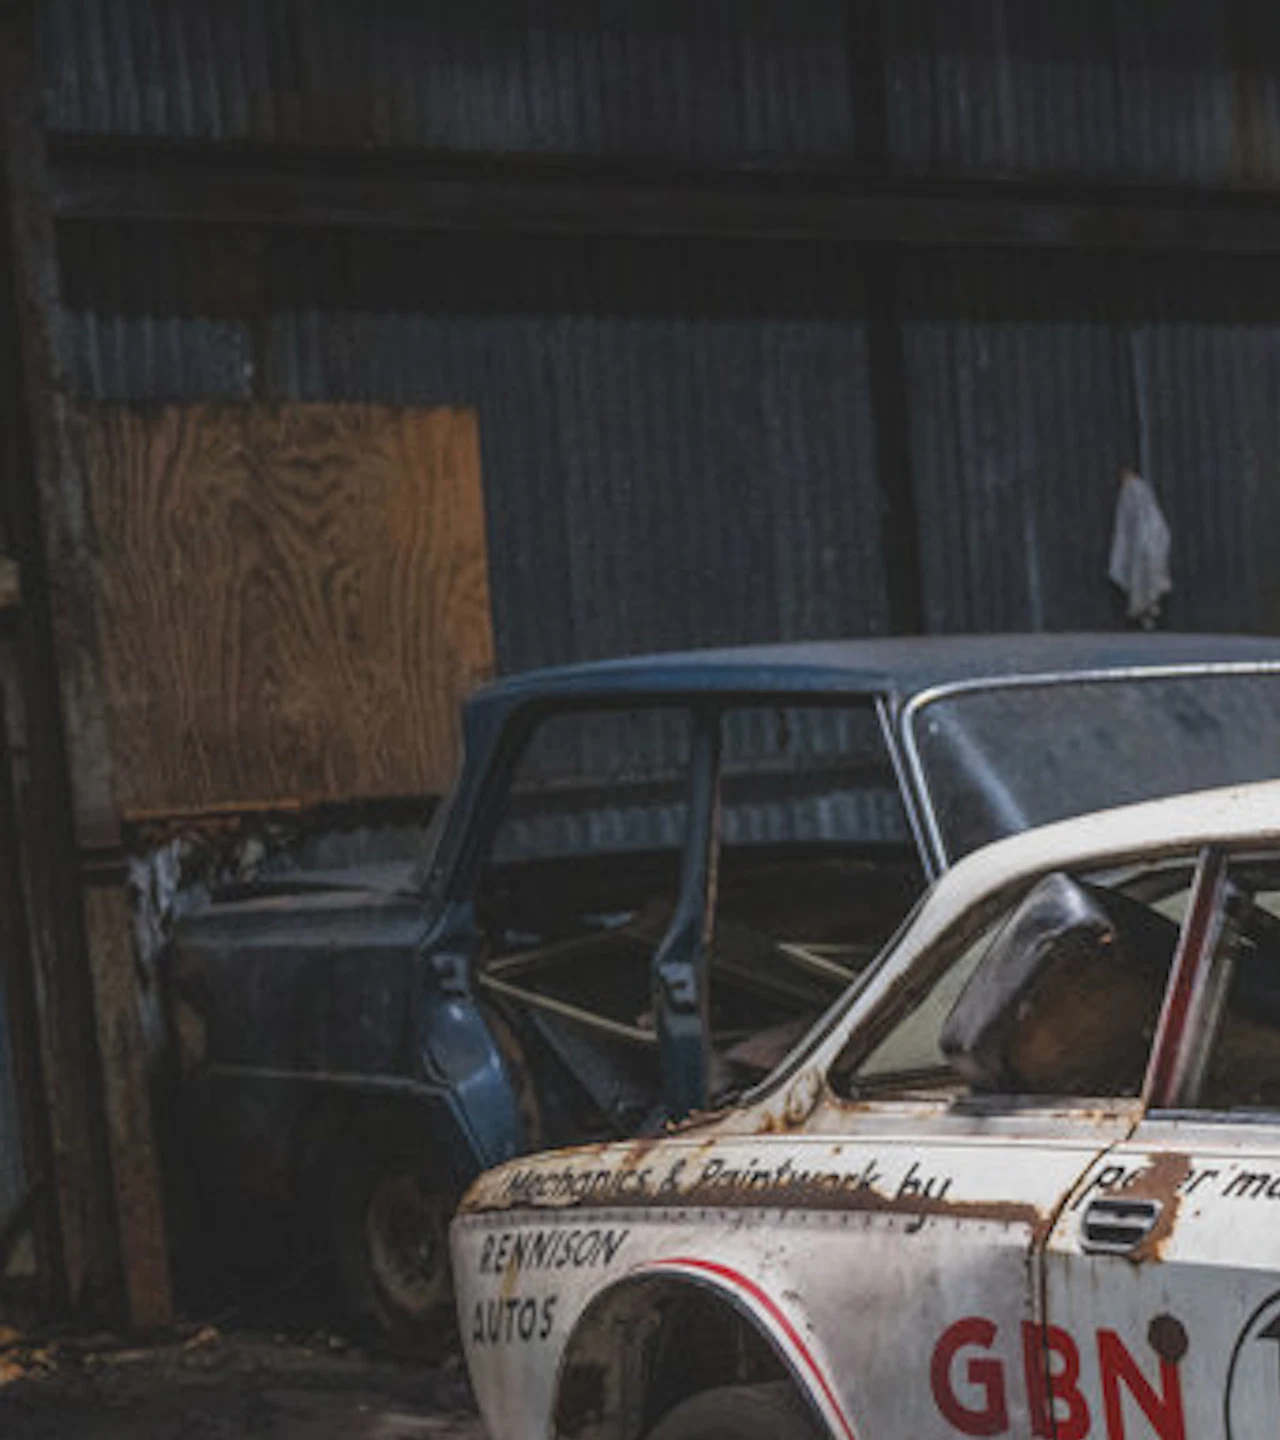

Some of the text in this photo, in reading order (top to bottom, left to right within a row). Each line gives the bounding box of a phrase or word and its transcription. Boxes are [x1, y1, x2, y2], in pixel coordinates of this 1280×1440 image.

[503, 1156, 953, 1234] Mechanics & Paintwork by
[473, 1294, 558, 1345] AUTOS
